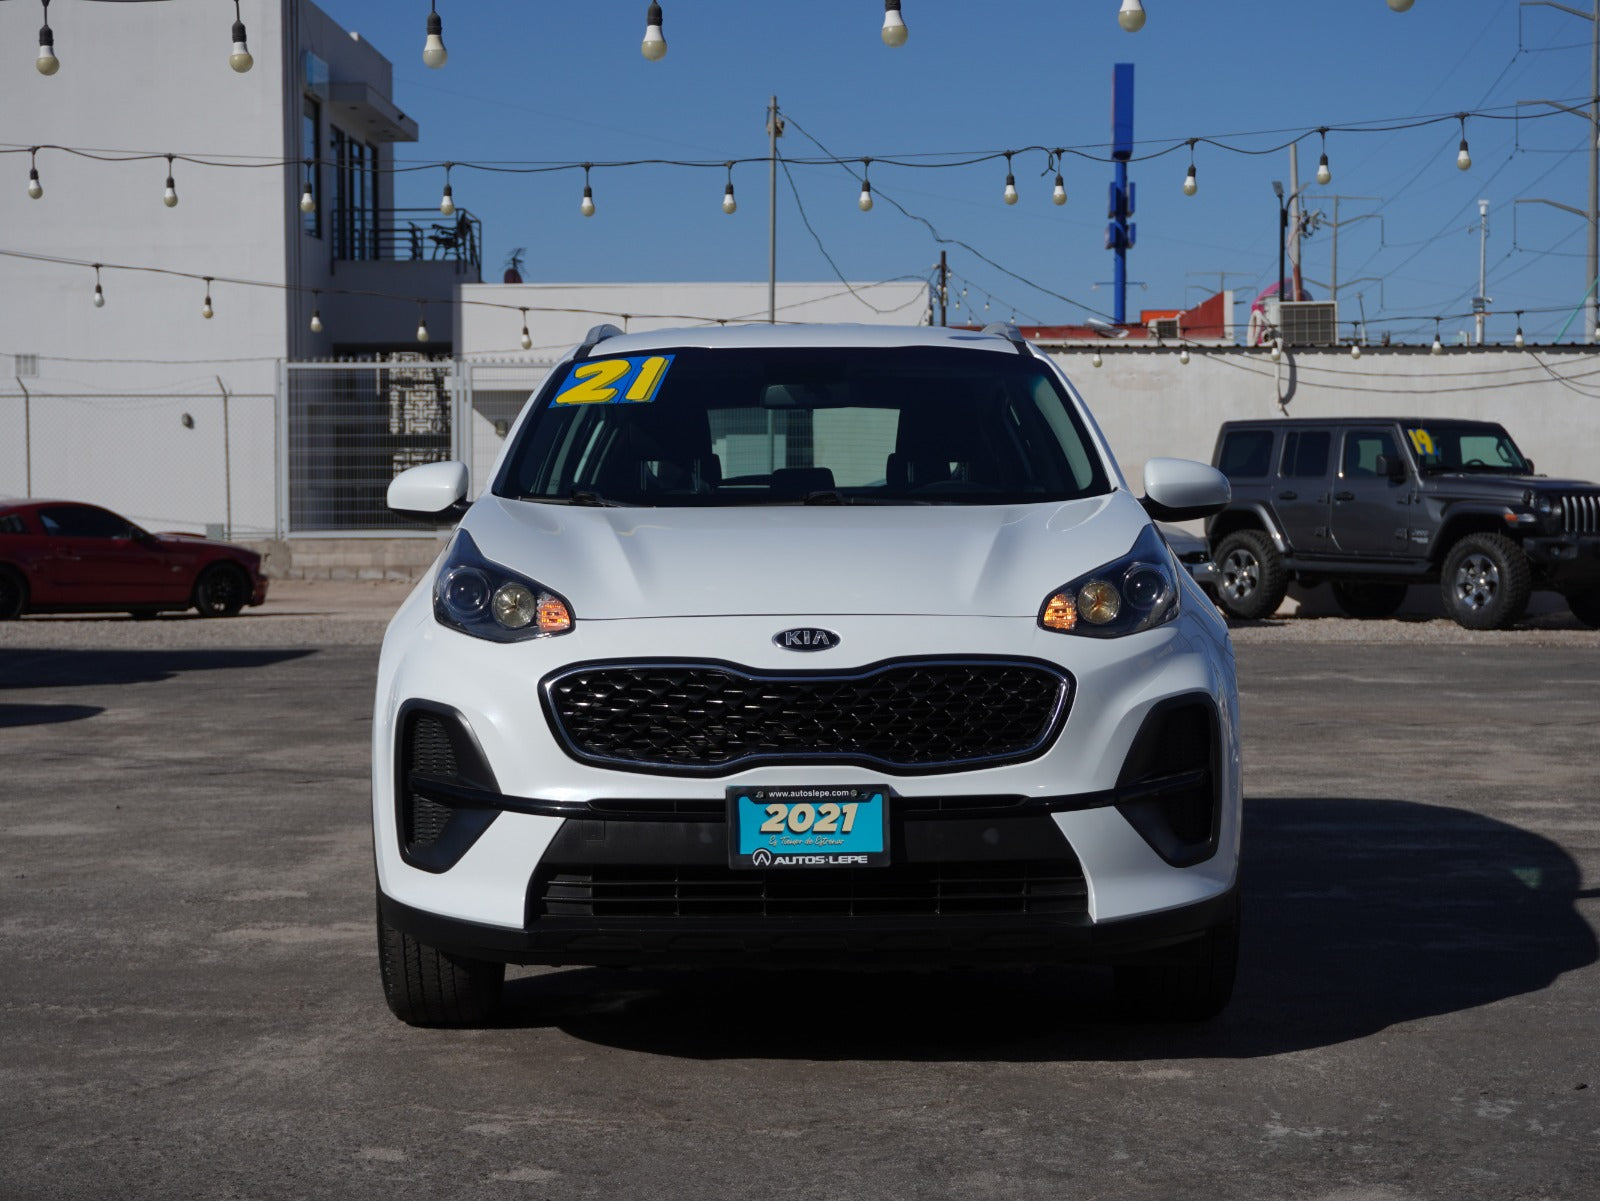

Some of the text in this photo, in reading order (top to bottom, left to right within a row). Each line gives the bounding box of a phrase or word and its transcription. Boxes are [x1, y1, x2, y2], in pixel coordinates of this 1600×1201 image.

[555, 356, 669, 405] 21
[1407, 428, 1434, 456] 19
[785, 630, 830, 646] KIA
[768, 789, 849, 797] www.autoslepe.com
[760, 803, 859, 833] 2021
